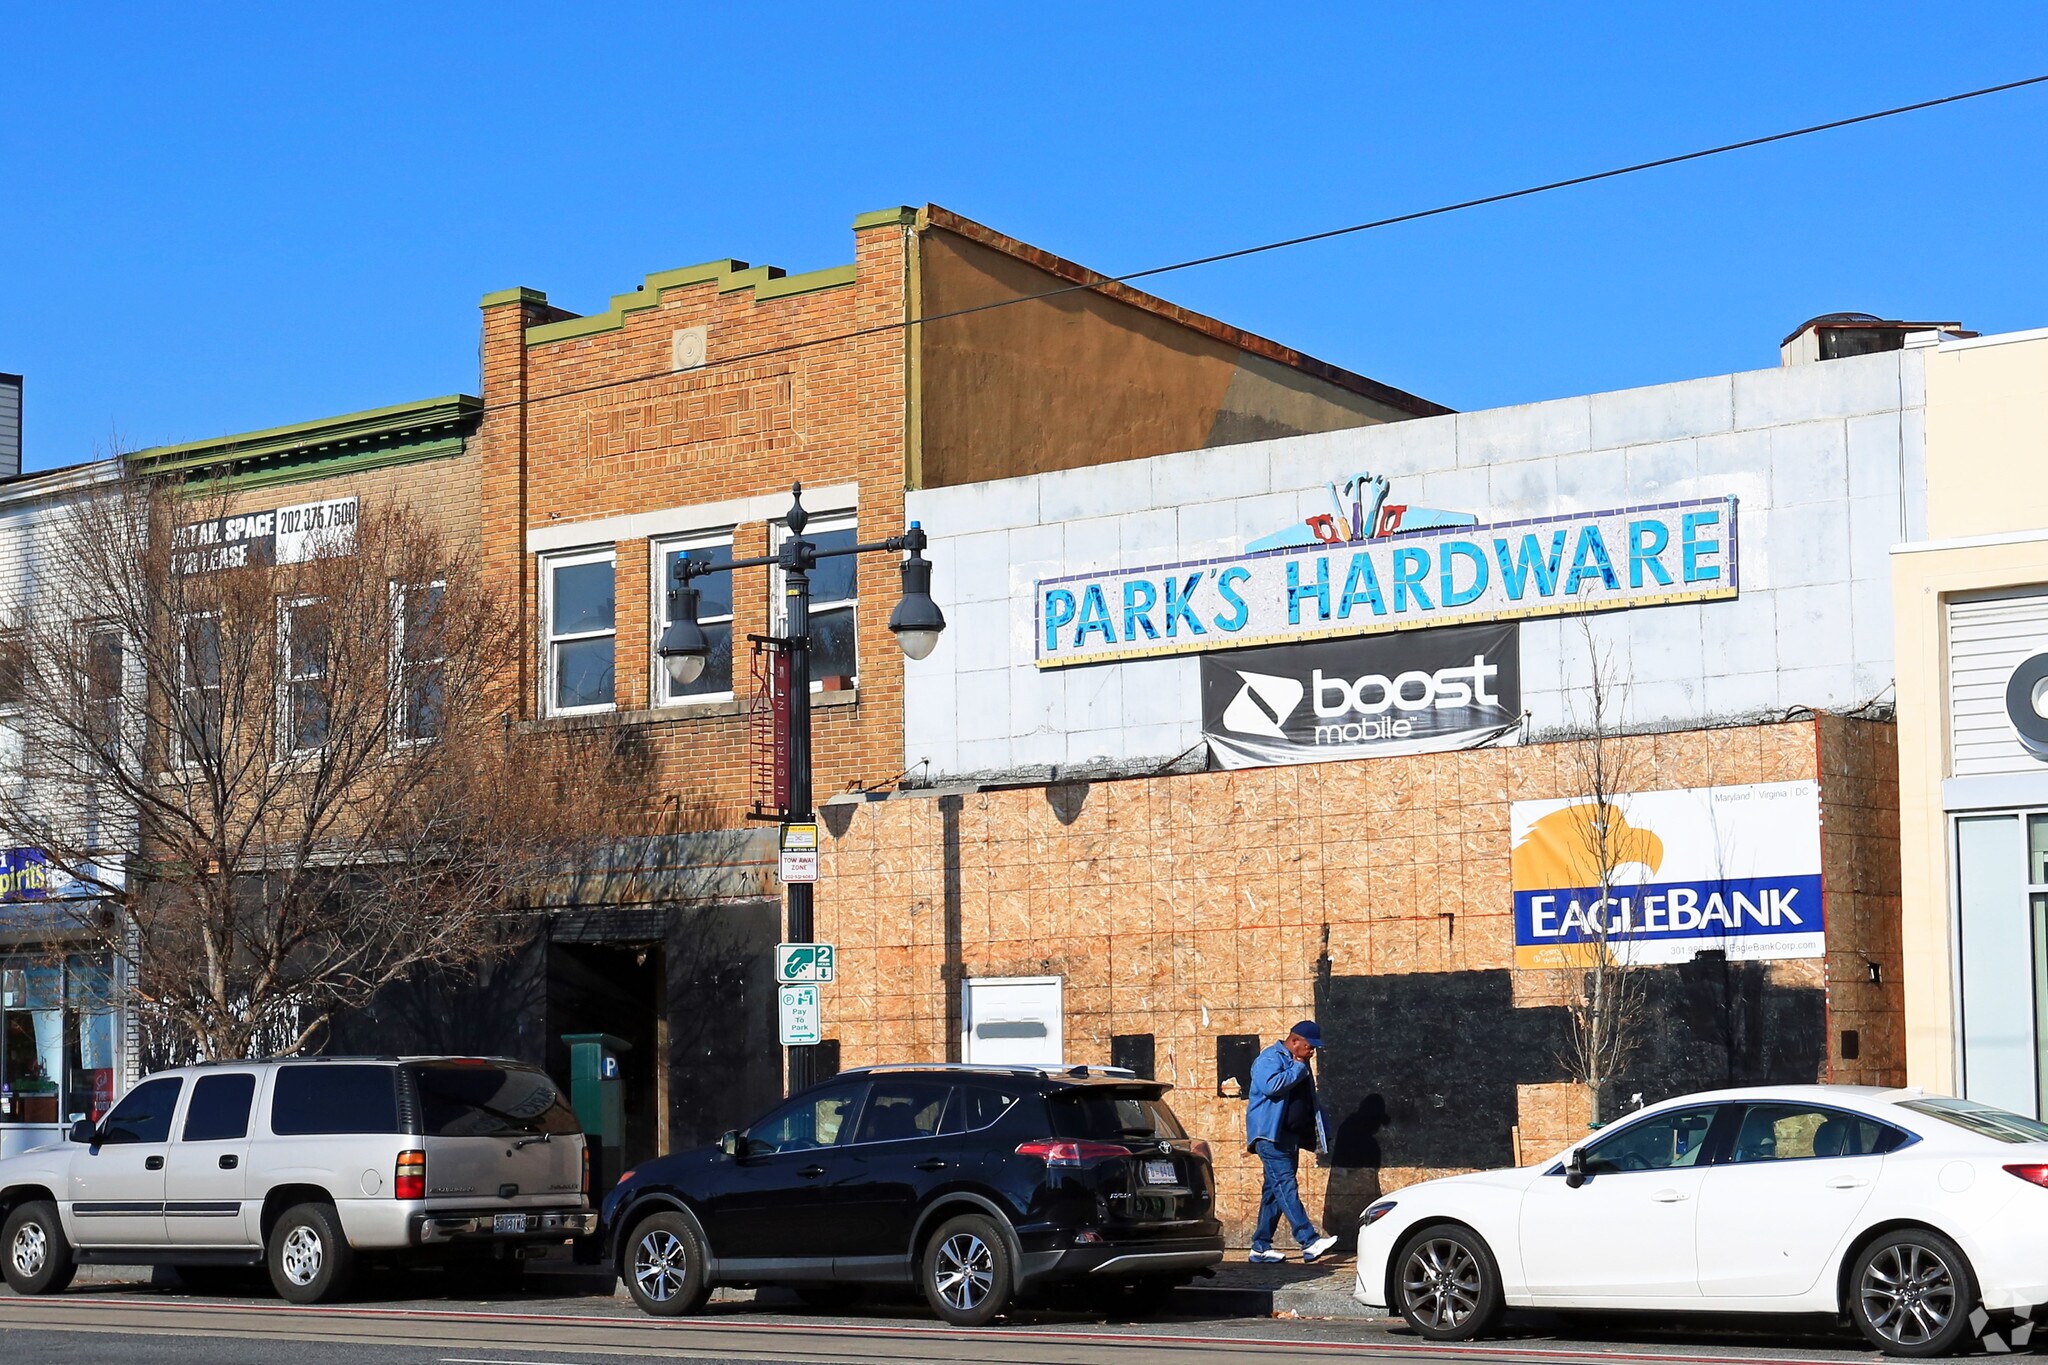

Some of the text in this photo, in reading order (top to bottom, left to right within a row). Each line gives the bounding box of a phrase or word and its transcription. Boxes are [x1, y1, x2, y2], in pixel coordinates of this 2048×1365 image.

[225, 513, 275, 542] SPACE
[1045, 510, 1720, 651] PARK'S HARDWARE
[1312, 654, 1498, 718] boost
[777, 719, 785, 776] STREET
[1715, 787, 1809, 802] Maryland Virginia DC
[817, 947, 831, 962] 2
[1729, 941, 1816, 955] EagleBankCorp.com
[792, 1008, 807, 1016] Pay
[606, 1057, 616, 1077] P
